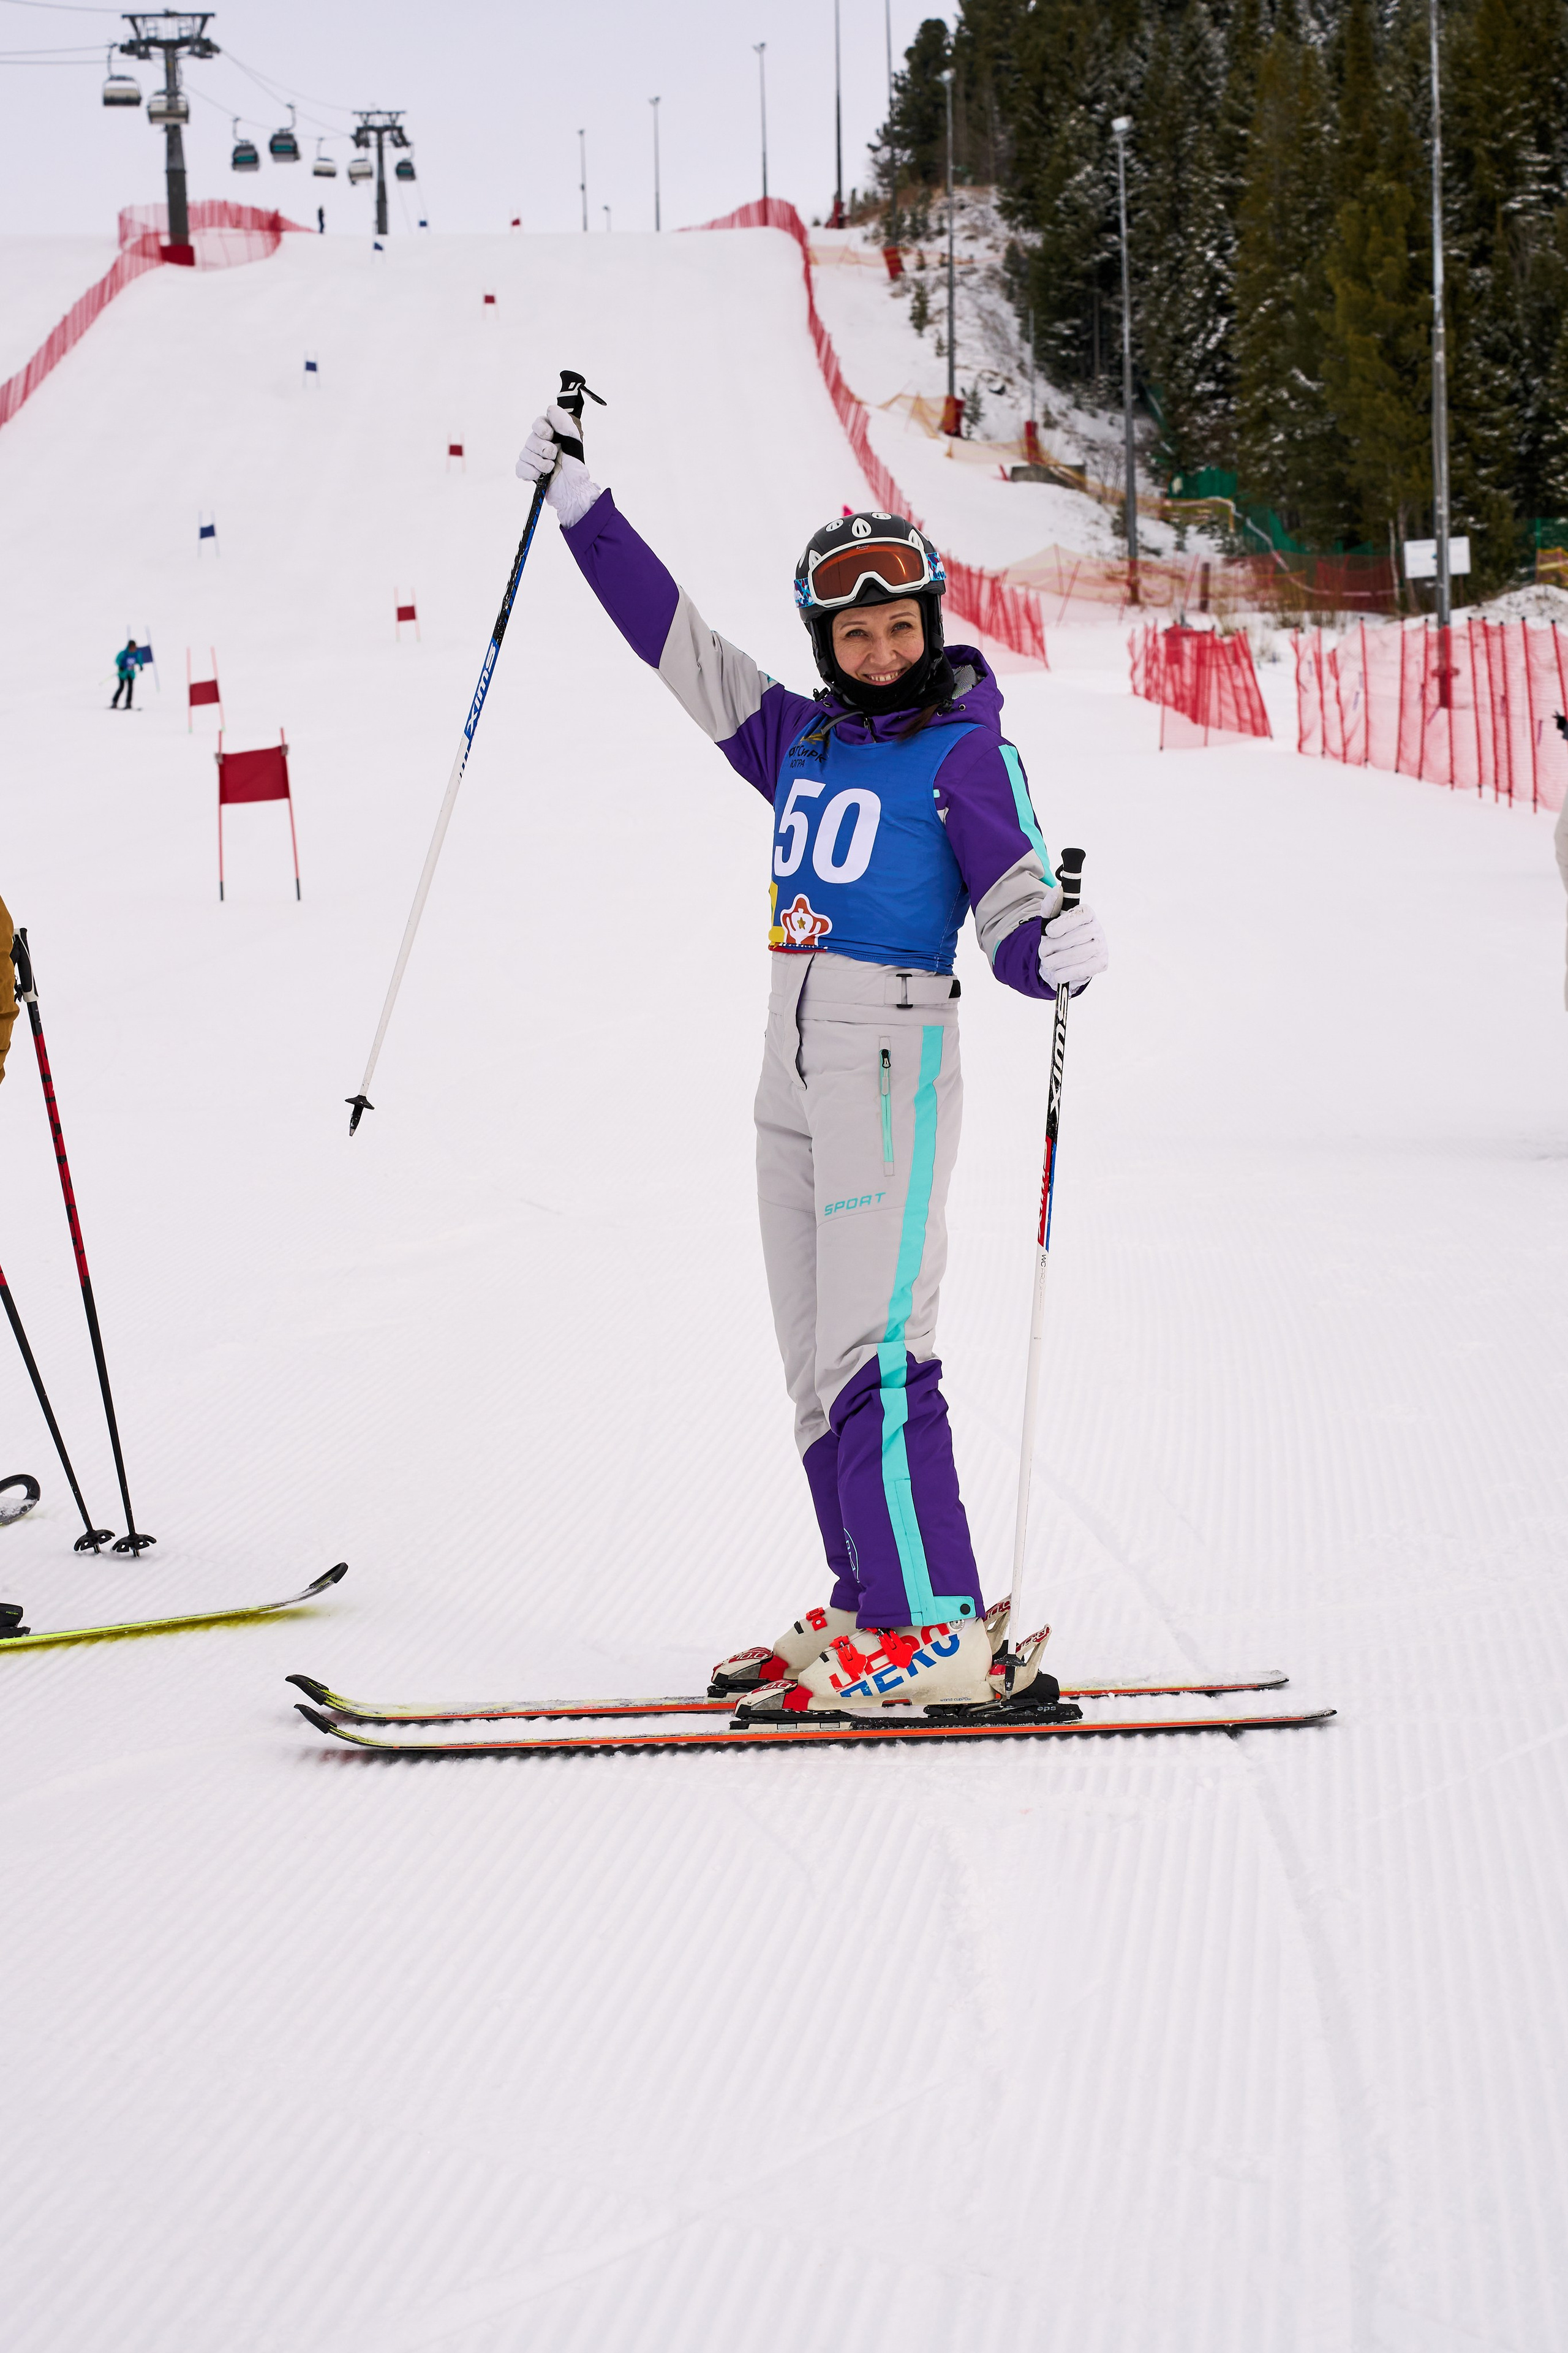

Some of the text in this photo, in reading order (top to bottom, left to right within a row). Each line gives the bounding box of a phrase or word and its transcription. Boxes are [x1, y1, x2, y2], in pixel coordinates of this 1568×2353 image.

[790, 759, 805, 768] ЮГРА
[774, 778, 882, 884] 50
[824, 1192, 887, 1217] SPORT
[760, 1682, 793, 1691] 10.0
